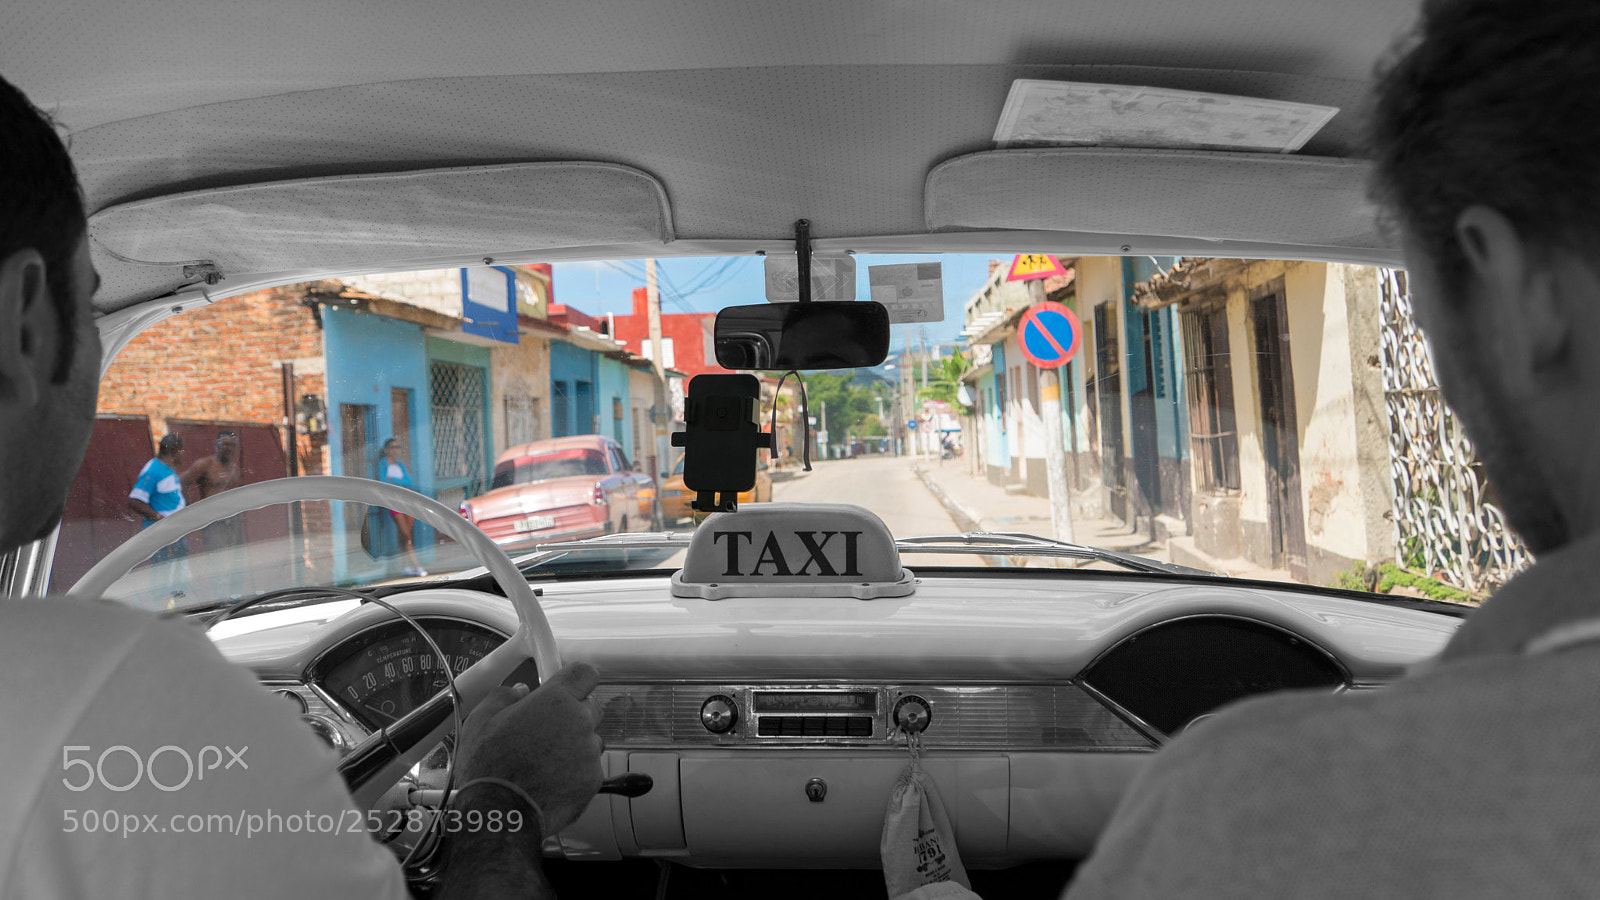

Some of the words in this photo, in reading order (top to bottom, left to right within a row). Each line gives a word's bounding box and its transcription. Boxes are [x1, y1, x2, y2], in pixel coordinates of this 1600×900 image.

[713, 530, 864, 577] TAXI
[347, 686, 359, 700] 0
[362, 672, 377, 690] 20
[384, 662, 396, 679] 40
[402, 656, 414, 673] 60
[420, 654, 432, 670] 80
[453, 655, 469, 671] 120
[376, 647, 413, 664] TEMPERATURE
